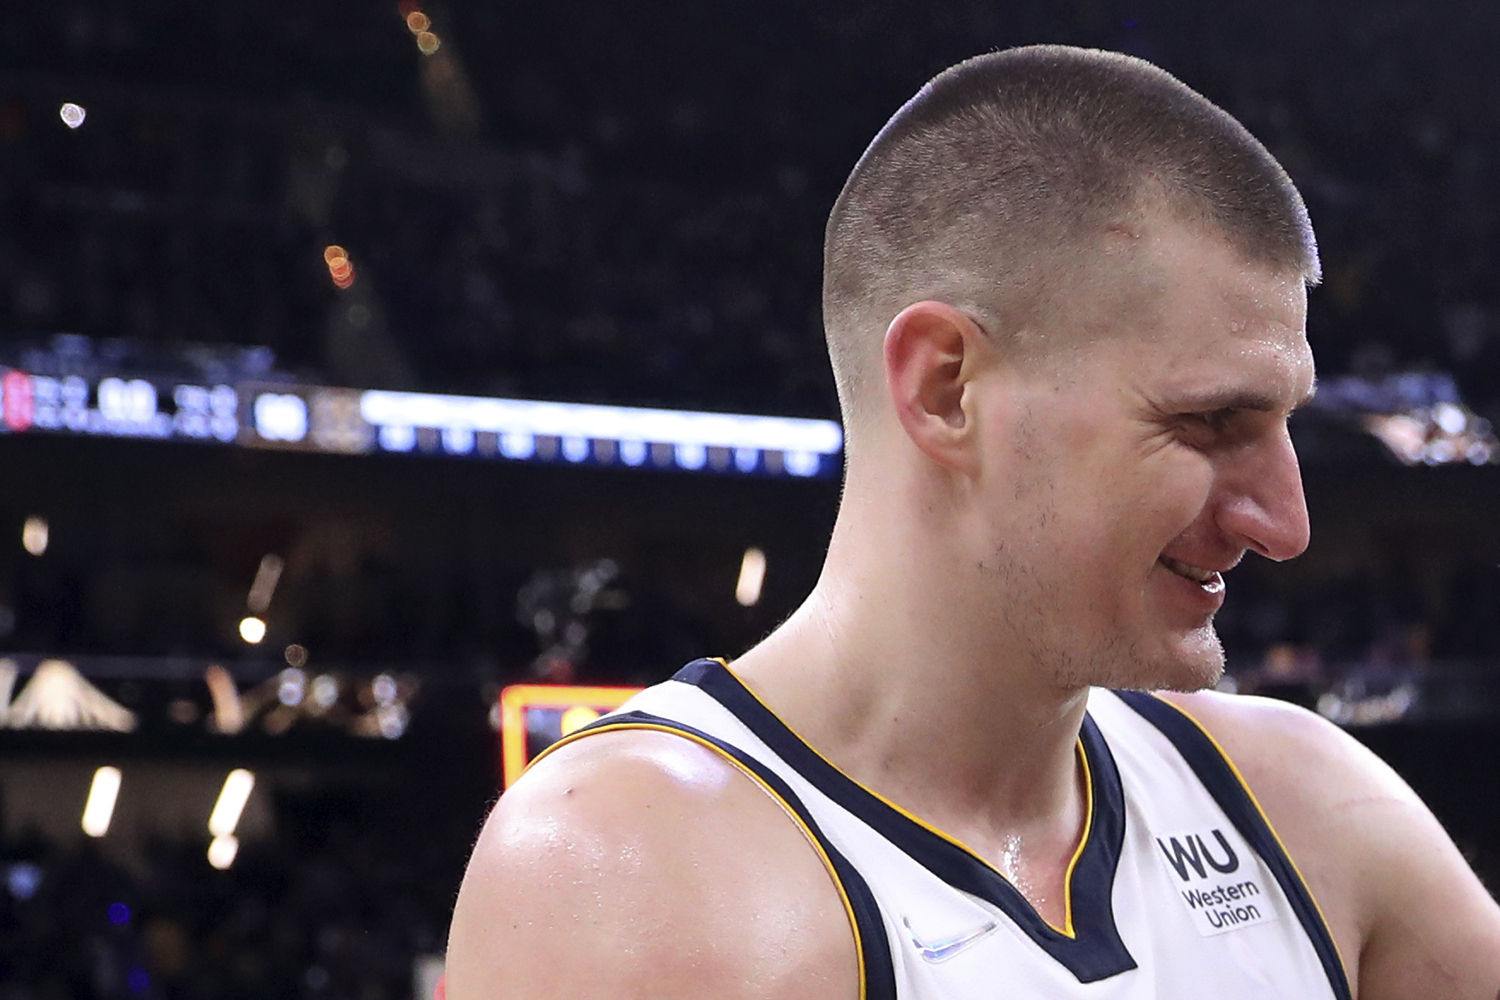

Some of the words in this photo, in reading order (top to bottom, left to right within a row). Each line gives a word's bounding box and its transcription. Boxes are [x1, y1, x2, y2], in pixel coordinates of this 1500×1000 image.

[1156, 828, 1239, 882] WU
[1181, 880, 1261, 909] Western
[1205, 904, 1262, 929] Union
